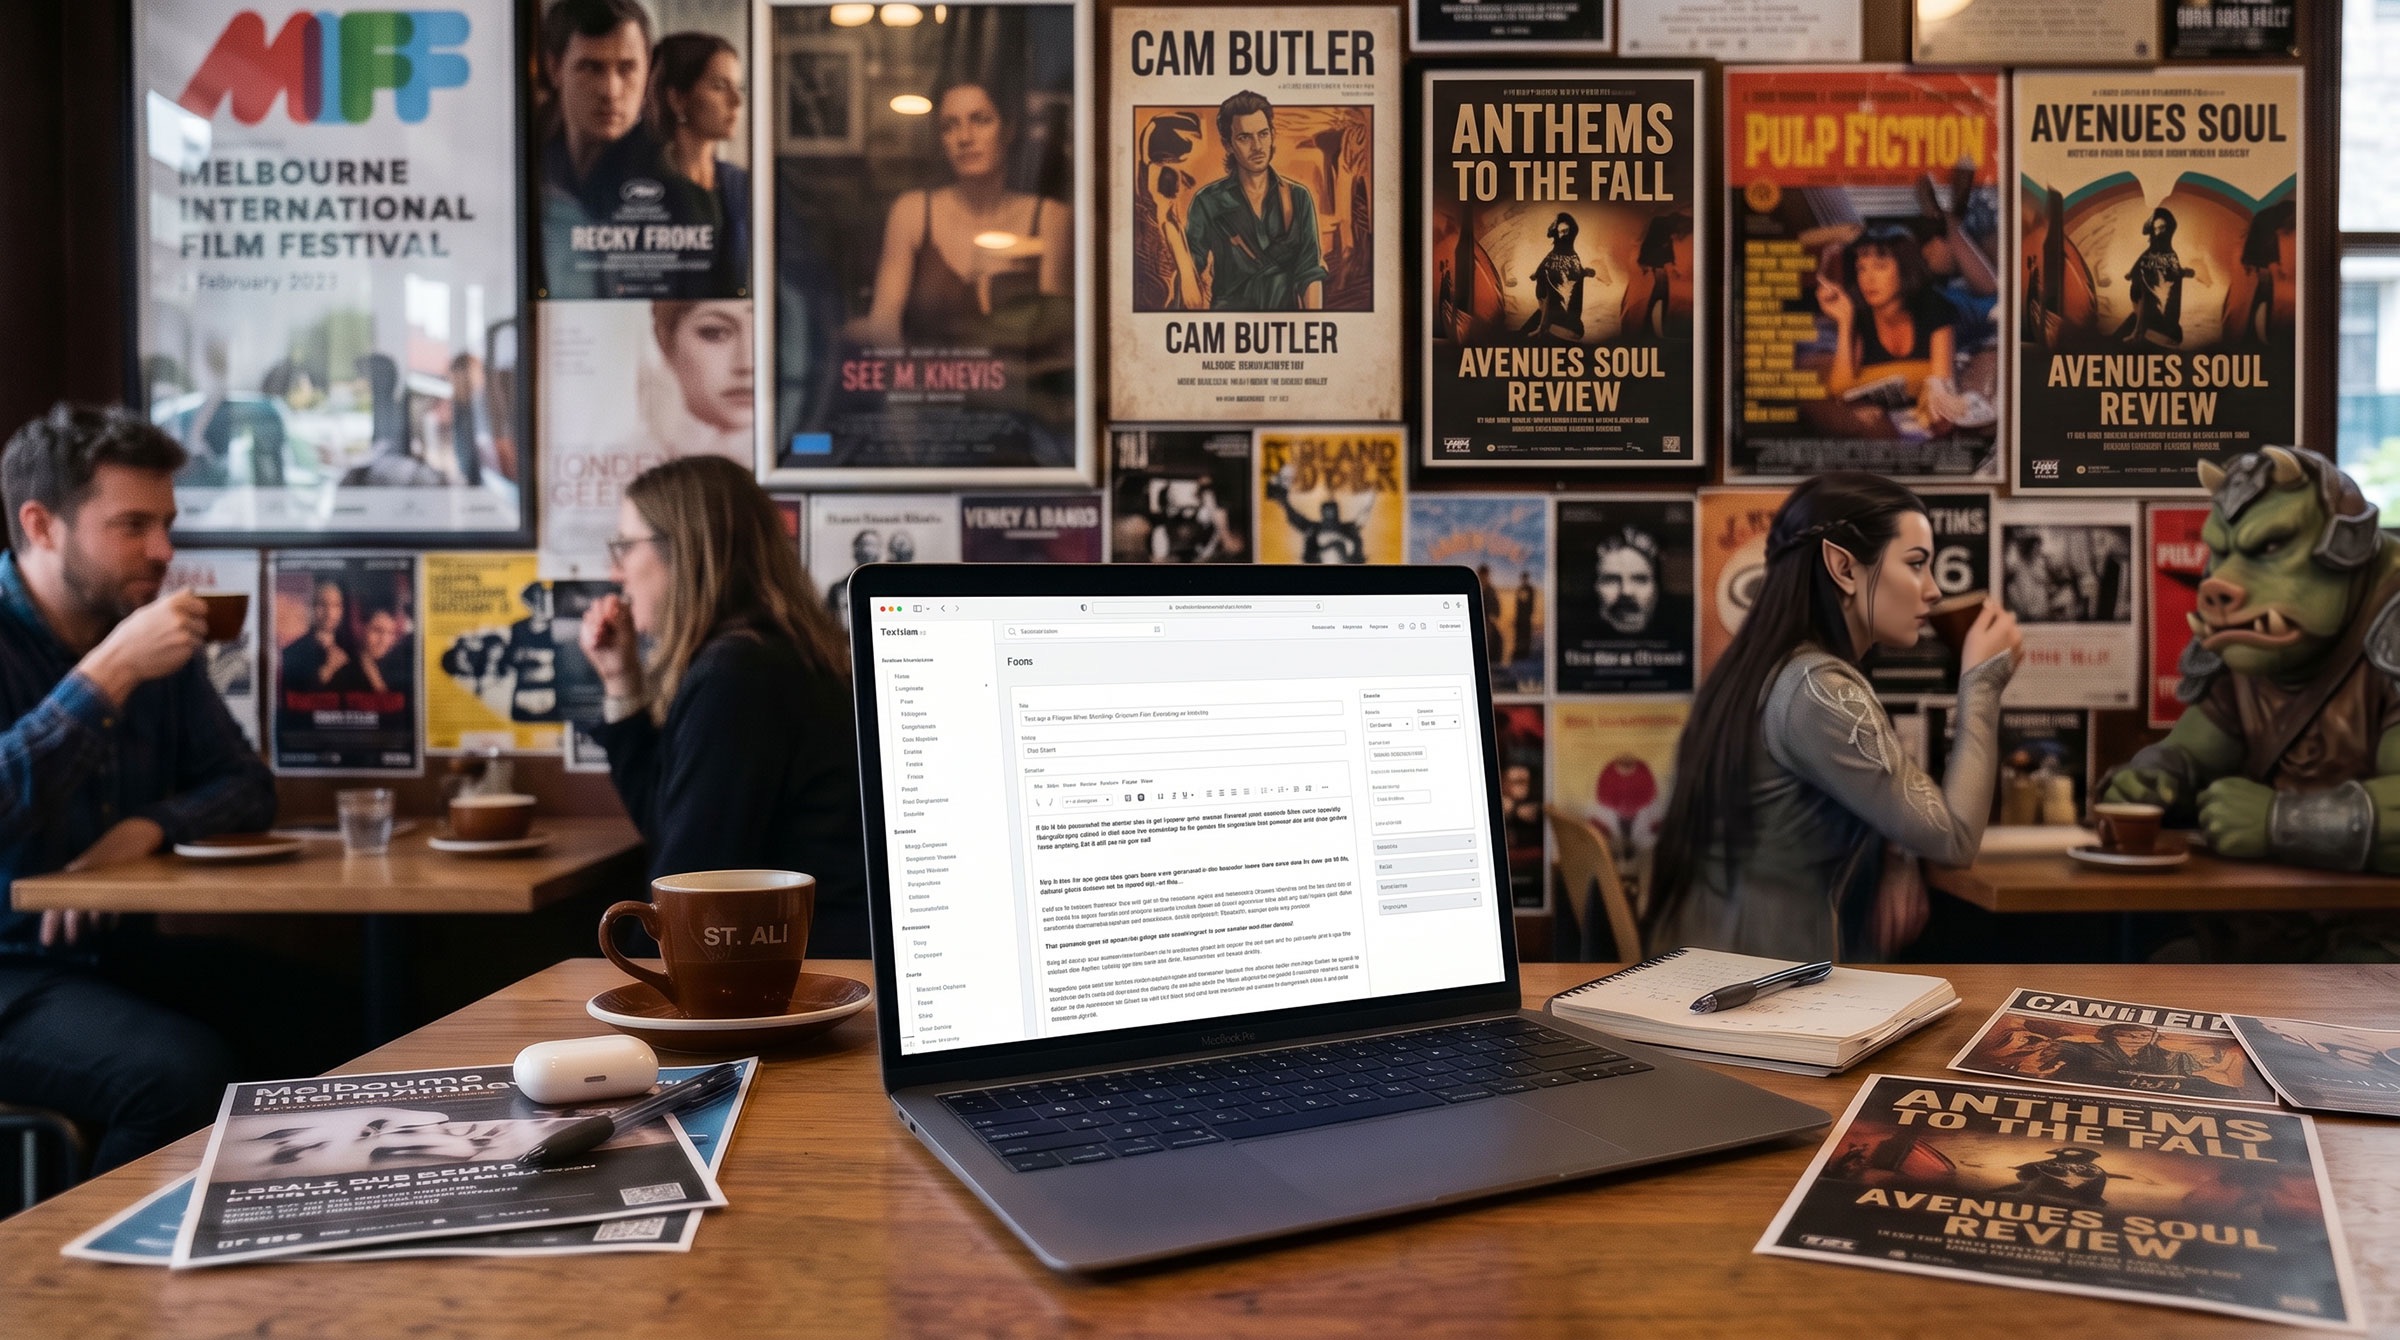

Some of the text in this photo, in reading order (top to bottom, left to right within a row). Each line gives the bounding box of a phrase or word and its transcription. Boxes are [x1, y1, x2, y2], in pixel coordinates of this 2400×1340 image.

[177, 10, 472, 126] MIFF
[1131, 29, 1375, 77] CAM BUTLER
[1451, 102, 1675, 155] ANTHEMS
[1744, 111, 1986, 169] PULP FICTION
[2031, 103, 2287, 143] AVENUES SOUL
[179, 158, 410, 187] MELBOURNE
[1452, 160, 1674, 202] TO THE FALL
[180, 196, 475, 222] INTERNATIONAL
[180, 231, 451, 258] FILM FESTIVAL
[1165, 320, 1339, 354] CAM BUTLER
[1458, 347, 1666, 378] AVENUES SOUL
[2048, 354, 2269, 388] AVENUES SOUL
[1508, 381, 1621, 413] REVIEW
[2101, 391, 2218, 425] REVIEW
[1934, 545, 1974, 594] 6
[703, 923, 788, 946] ST. ALI
[1893, 1089, 2273, 1142] ANTHEMS
[1893, 1107, 2279, 1163] TO THE FALL
[1855, 1187, 2278, 1252] AVENUES SOUL
[1944, 1215, 2184, 1261] REVIEW
